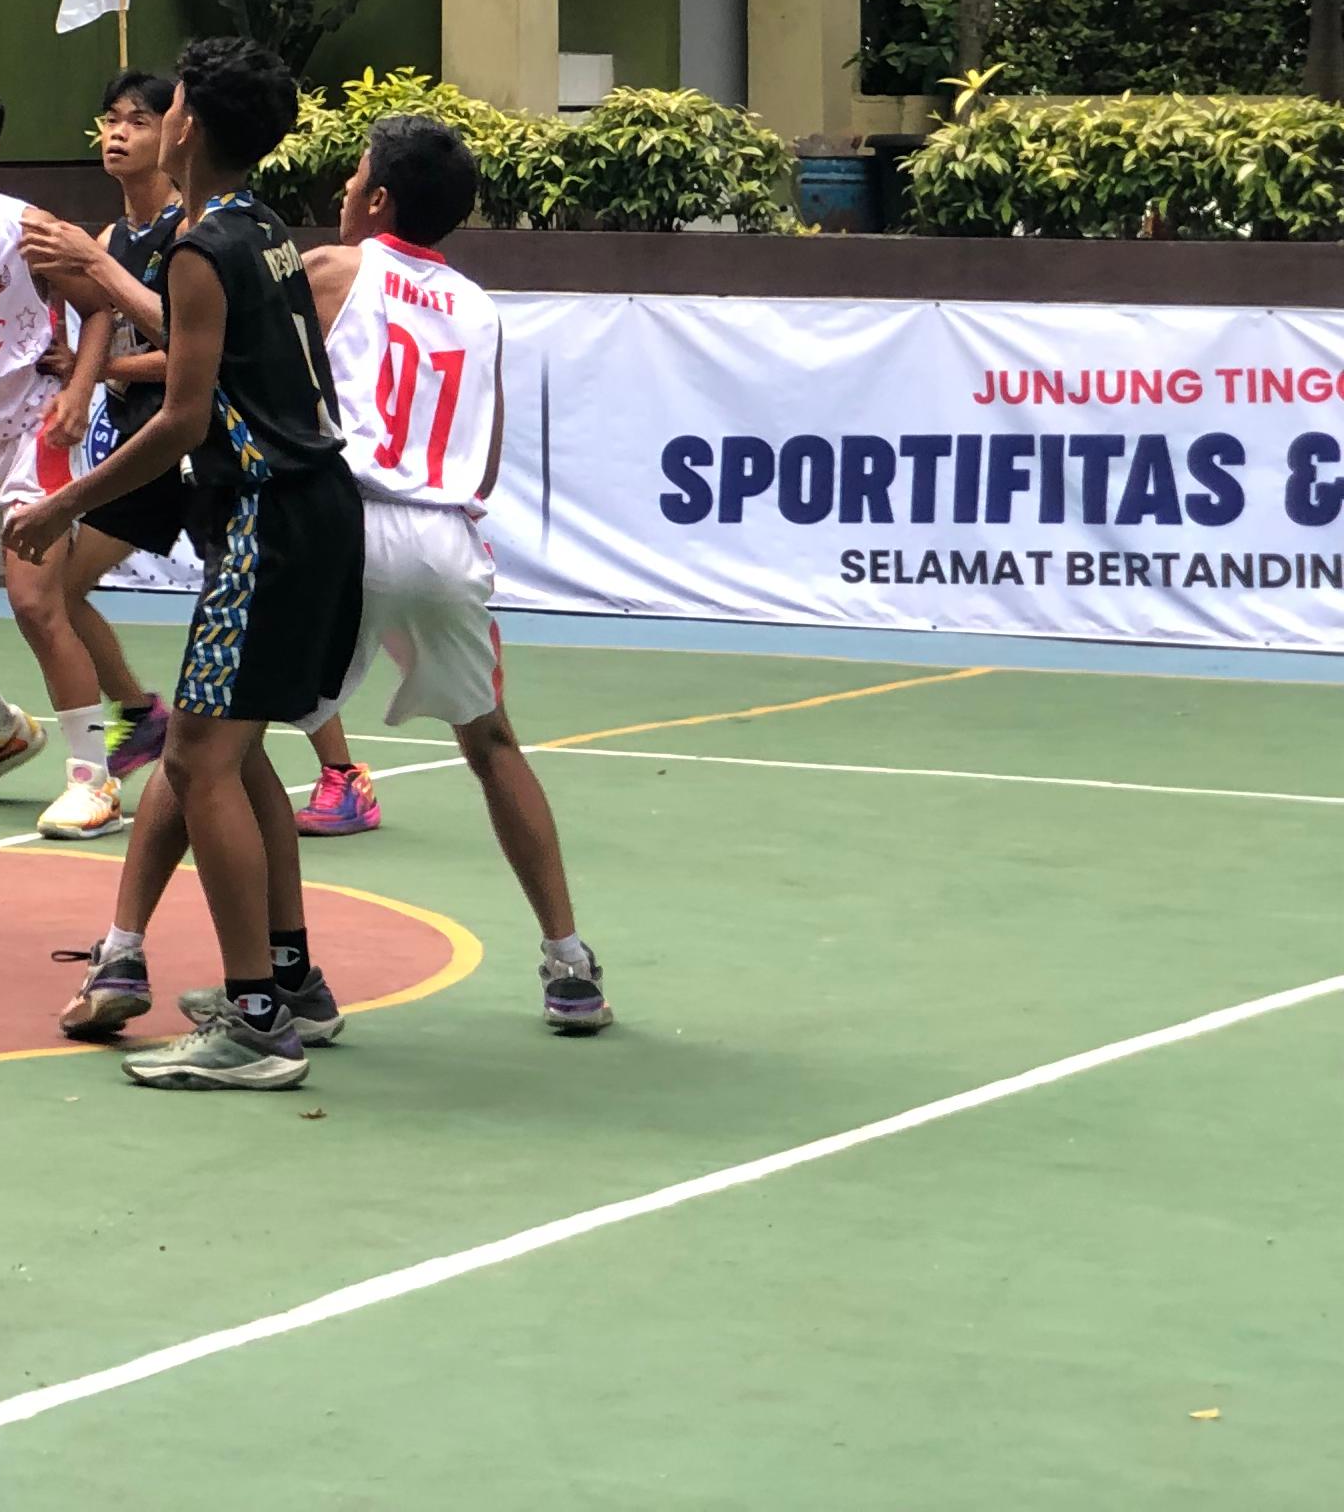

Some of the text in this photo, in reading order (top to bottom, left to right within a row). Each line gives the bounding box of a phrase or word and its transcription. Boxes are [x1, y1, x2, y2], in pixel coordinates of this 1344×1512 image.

[973, 367, 1344, 405] JUNJUNG TING
[659, 431, 1344, 527] SPORTIFITAS &
[840, 549, 1344, 590] SELAMAT BERTANDIN
